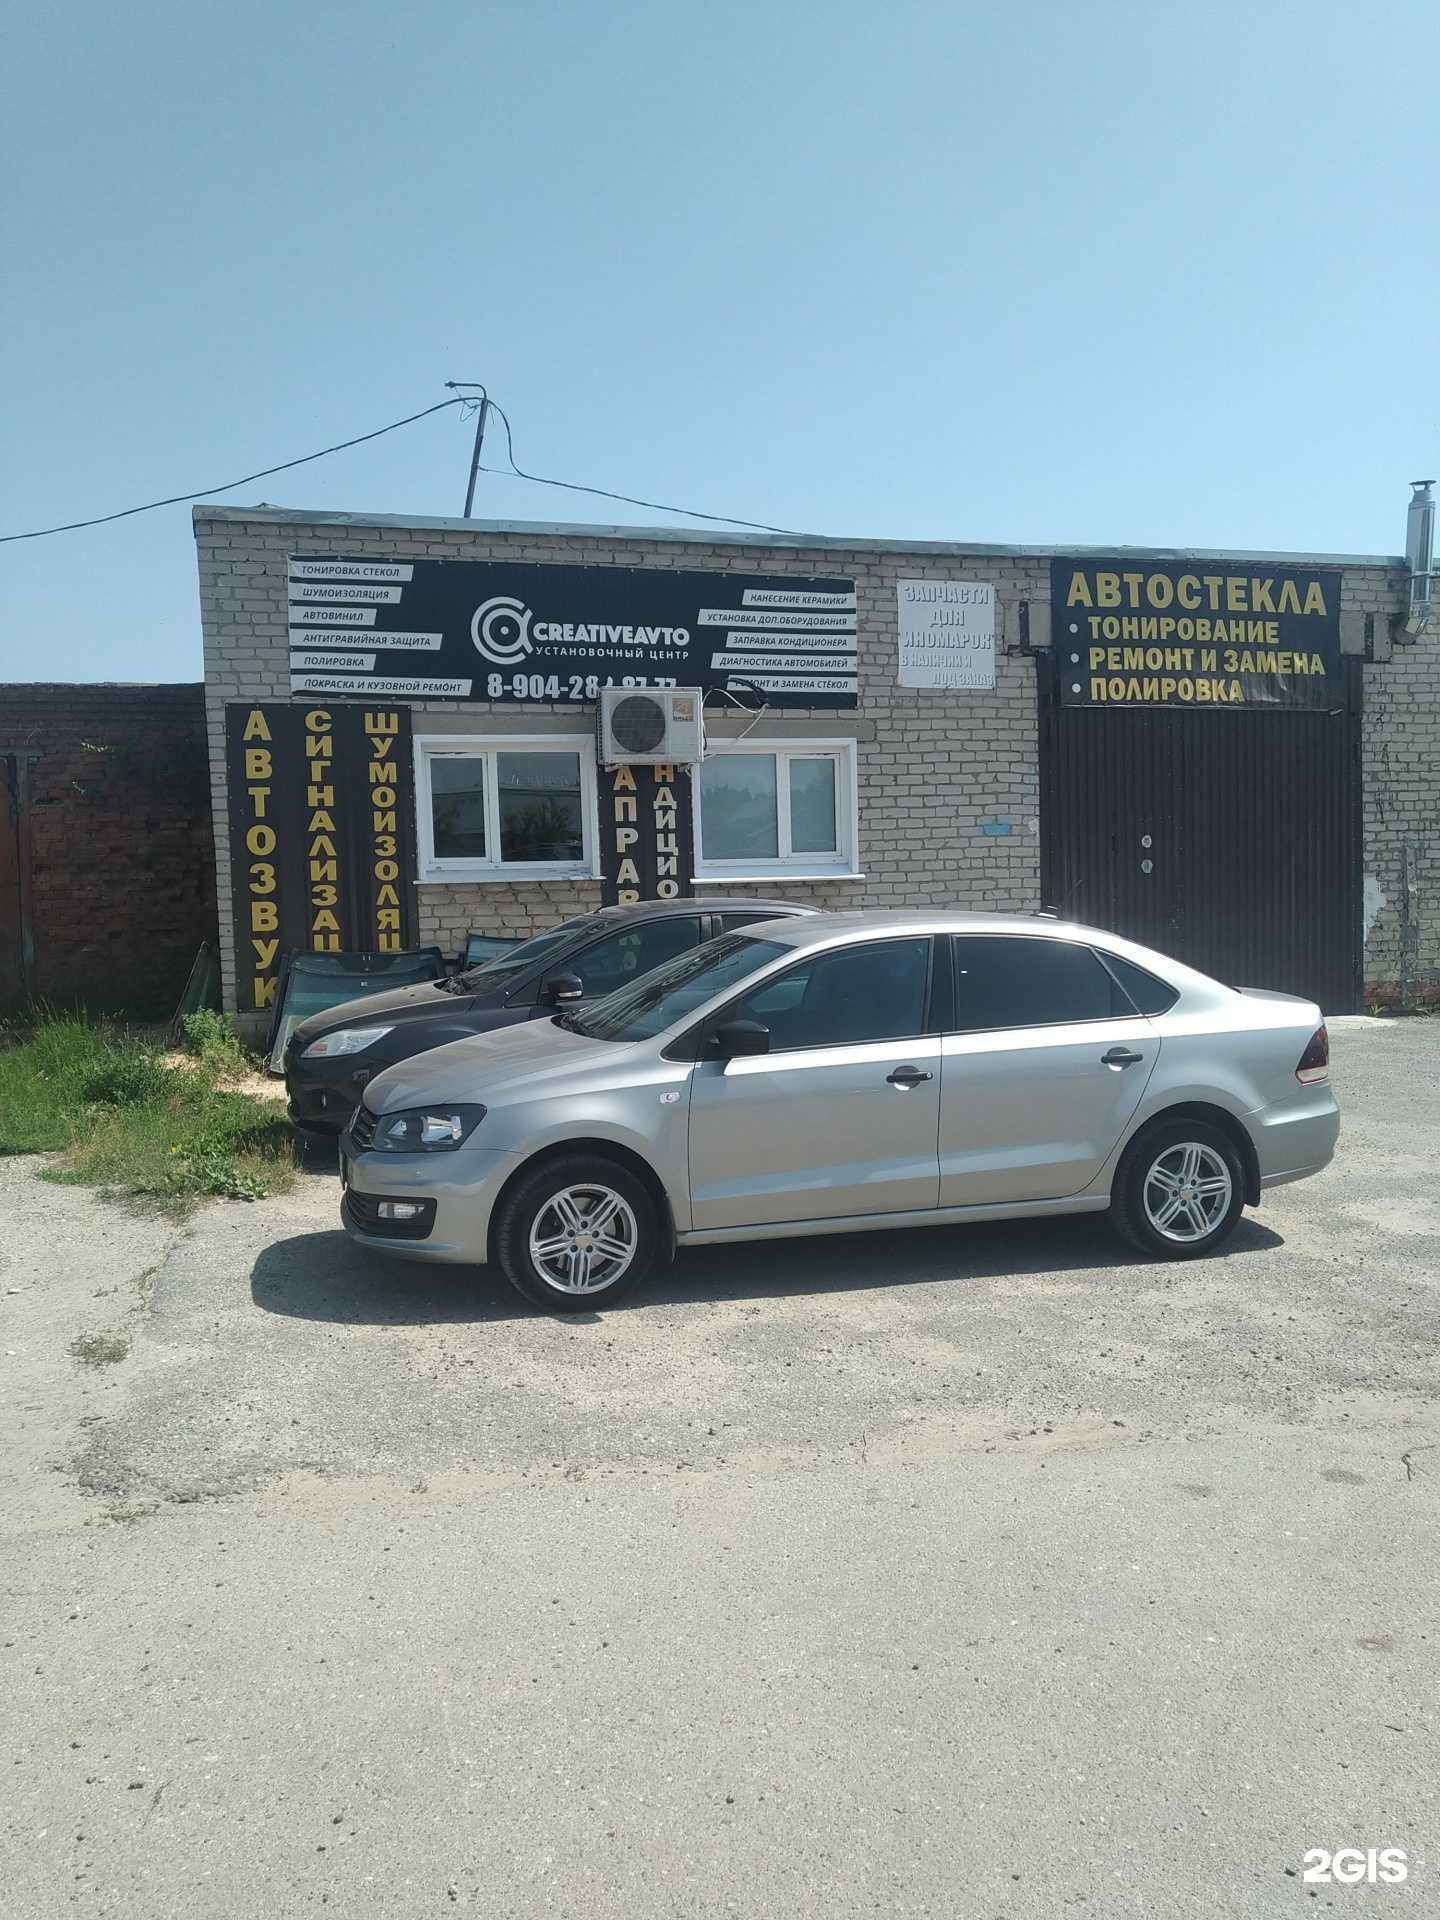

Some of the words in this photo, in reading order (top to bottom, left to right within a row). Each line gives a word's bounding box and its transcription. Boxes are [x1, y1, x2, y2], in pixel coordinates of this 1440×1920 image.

[302, 565, 361, 577] ТОНИРОВКА
[363, 567, 400, 577] СТЕКОЛ
[302, 588, 390, 600] ШУМОИЗОЛЯЦИЯ
[750, 593, 800, 604] НАНЕСЕНИЕ
[801, 596, 848, 605] КЕРАМИКИ
[1066, 571, 1327, 616] АВТОСТЕКЛА
[302, 611, 364, 622] АВТОВИНИЛ
[706, 613, 757, 623] УСТАНОВКА
[533, 622, 690, 646] CREATIVEAVTO
[1088, 616, 1280, 644] ТОНИРОВАНИЕ
[303, 633, 388, 646] АНТИГРАВИЙНАЯ
[390, 635, 431, 648] ЗАЩИТА
[732, 636, 776, 646] ЗАПРАВКА
[778, 637, 848, 648] КОНДИЦИОНЕРА
[535, 646, 644, 659] УСТАНОВОЧНЫЙ
[650, 650, 689, 661] ЦЕНТР
[1089, 647, 1195, 671] РЕМОНТ
[1201, 649, 1217, 672] И
[1223, 650, 1326, 675] ЗАМЕНА
[304, 656, 365, 667] ПОЛИРОВКА
[720, 657, 782, 667] ДИАГНОСТИКА
[784, 658, 848, 668] АВТОМОБИЛЕЙ
[304, 678, 355, 690] ПОКРАСКА
[357, 680, 365, 690] И
[367, 679, 421, 692] КУЗОВНОЙ
[422, 682, 463, 692] РЕМОНТ
[487, 673, 677, 699] 8-904-28
[736, 679, 771, 688] ОНТ
[772, 679, 779, 688] И
[781, 680, 815, 688] ЗАМЕНА
[817, 680, 849, 689] СТЕКОЛ
[1090, 677, 1245, 702] ПОЛИРОВКА
[303, 710, 343, 953] СИГНАЛИЗАЦ
[364, 711, 403, 953] ШУМОИЗОЛЯЦ
[613, 764, 640, 905] АПРАВ
[653, 764, 679, 899] НДИЦИО
[243, 710, 280, 1008] АВТОЗВУК
